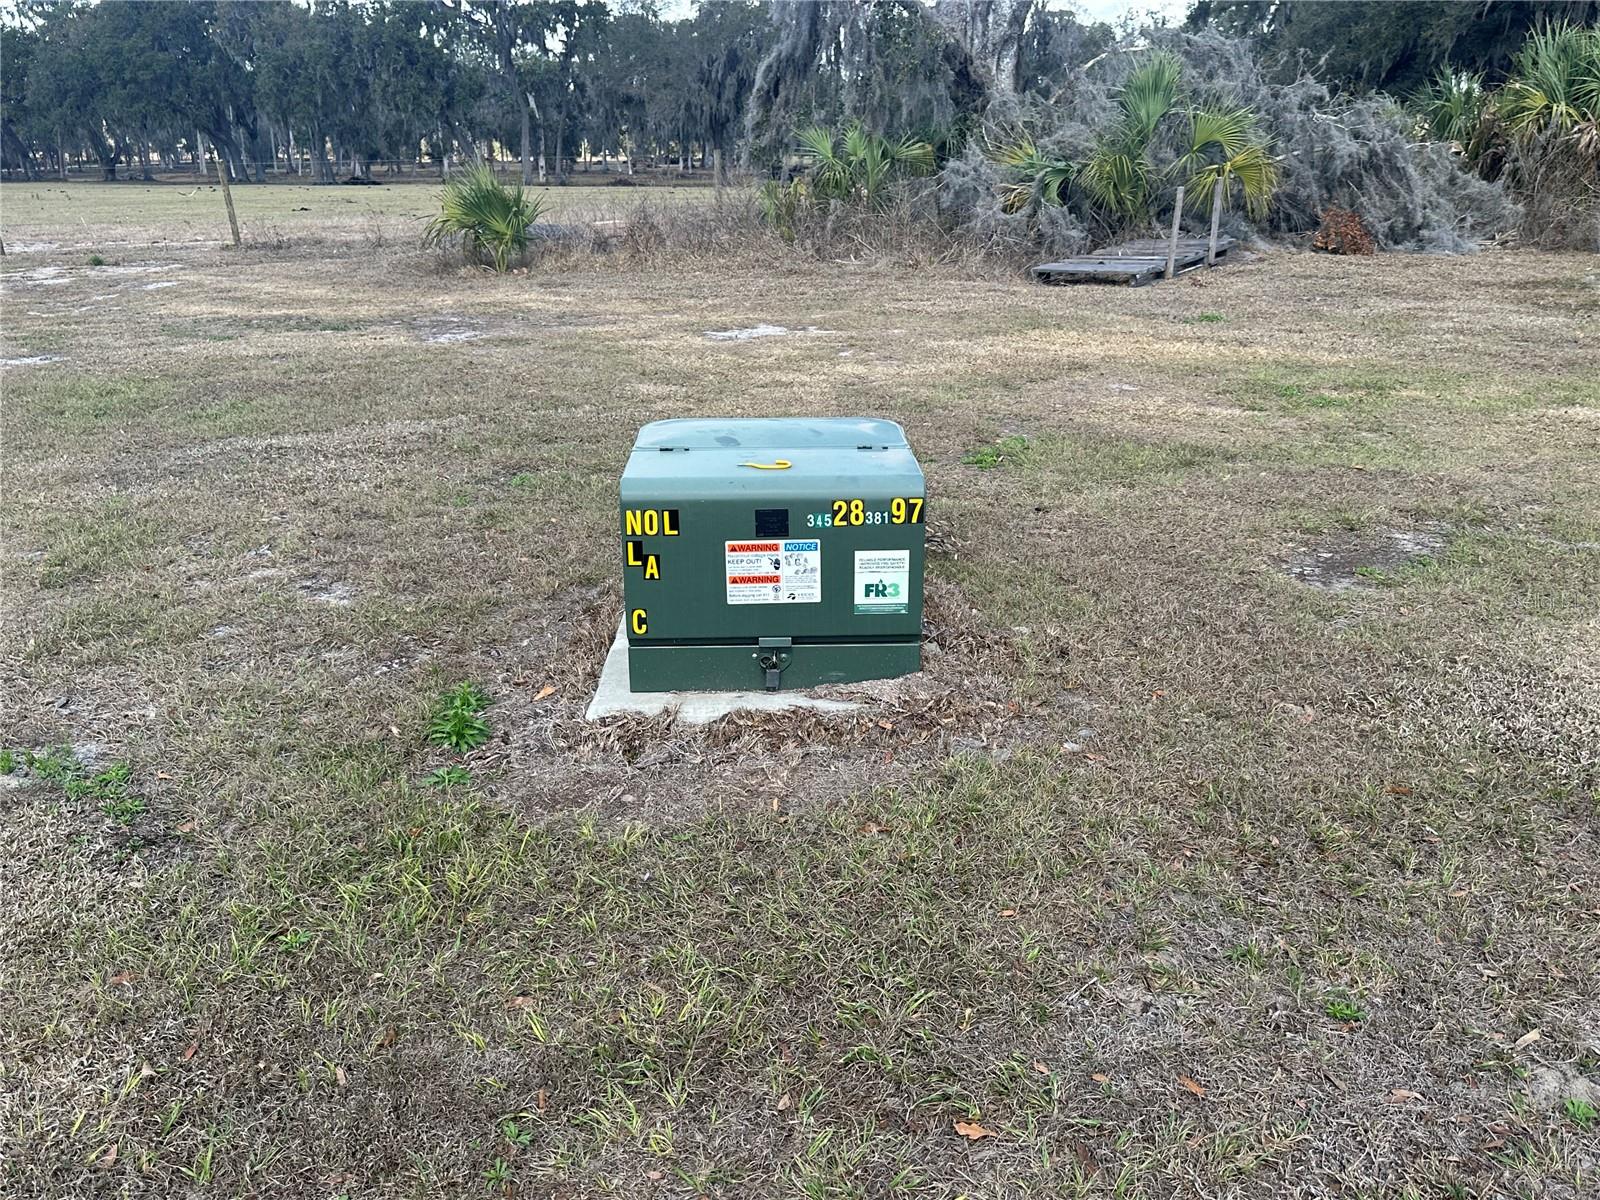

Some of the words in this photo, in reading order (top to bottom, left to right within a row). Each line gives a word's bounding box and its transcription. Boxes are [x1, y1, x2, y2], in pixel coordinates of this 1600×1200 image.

[737, 543, 778, 552] WARNING
[785, 543, 817, 551] NOTICE
[738, 576, 779, 584] WARNING
[864, 583, 901, 598] FR3
[632, 609, 647, 635] C
